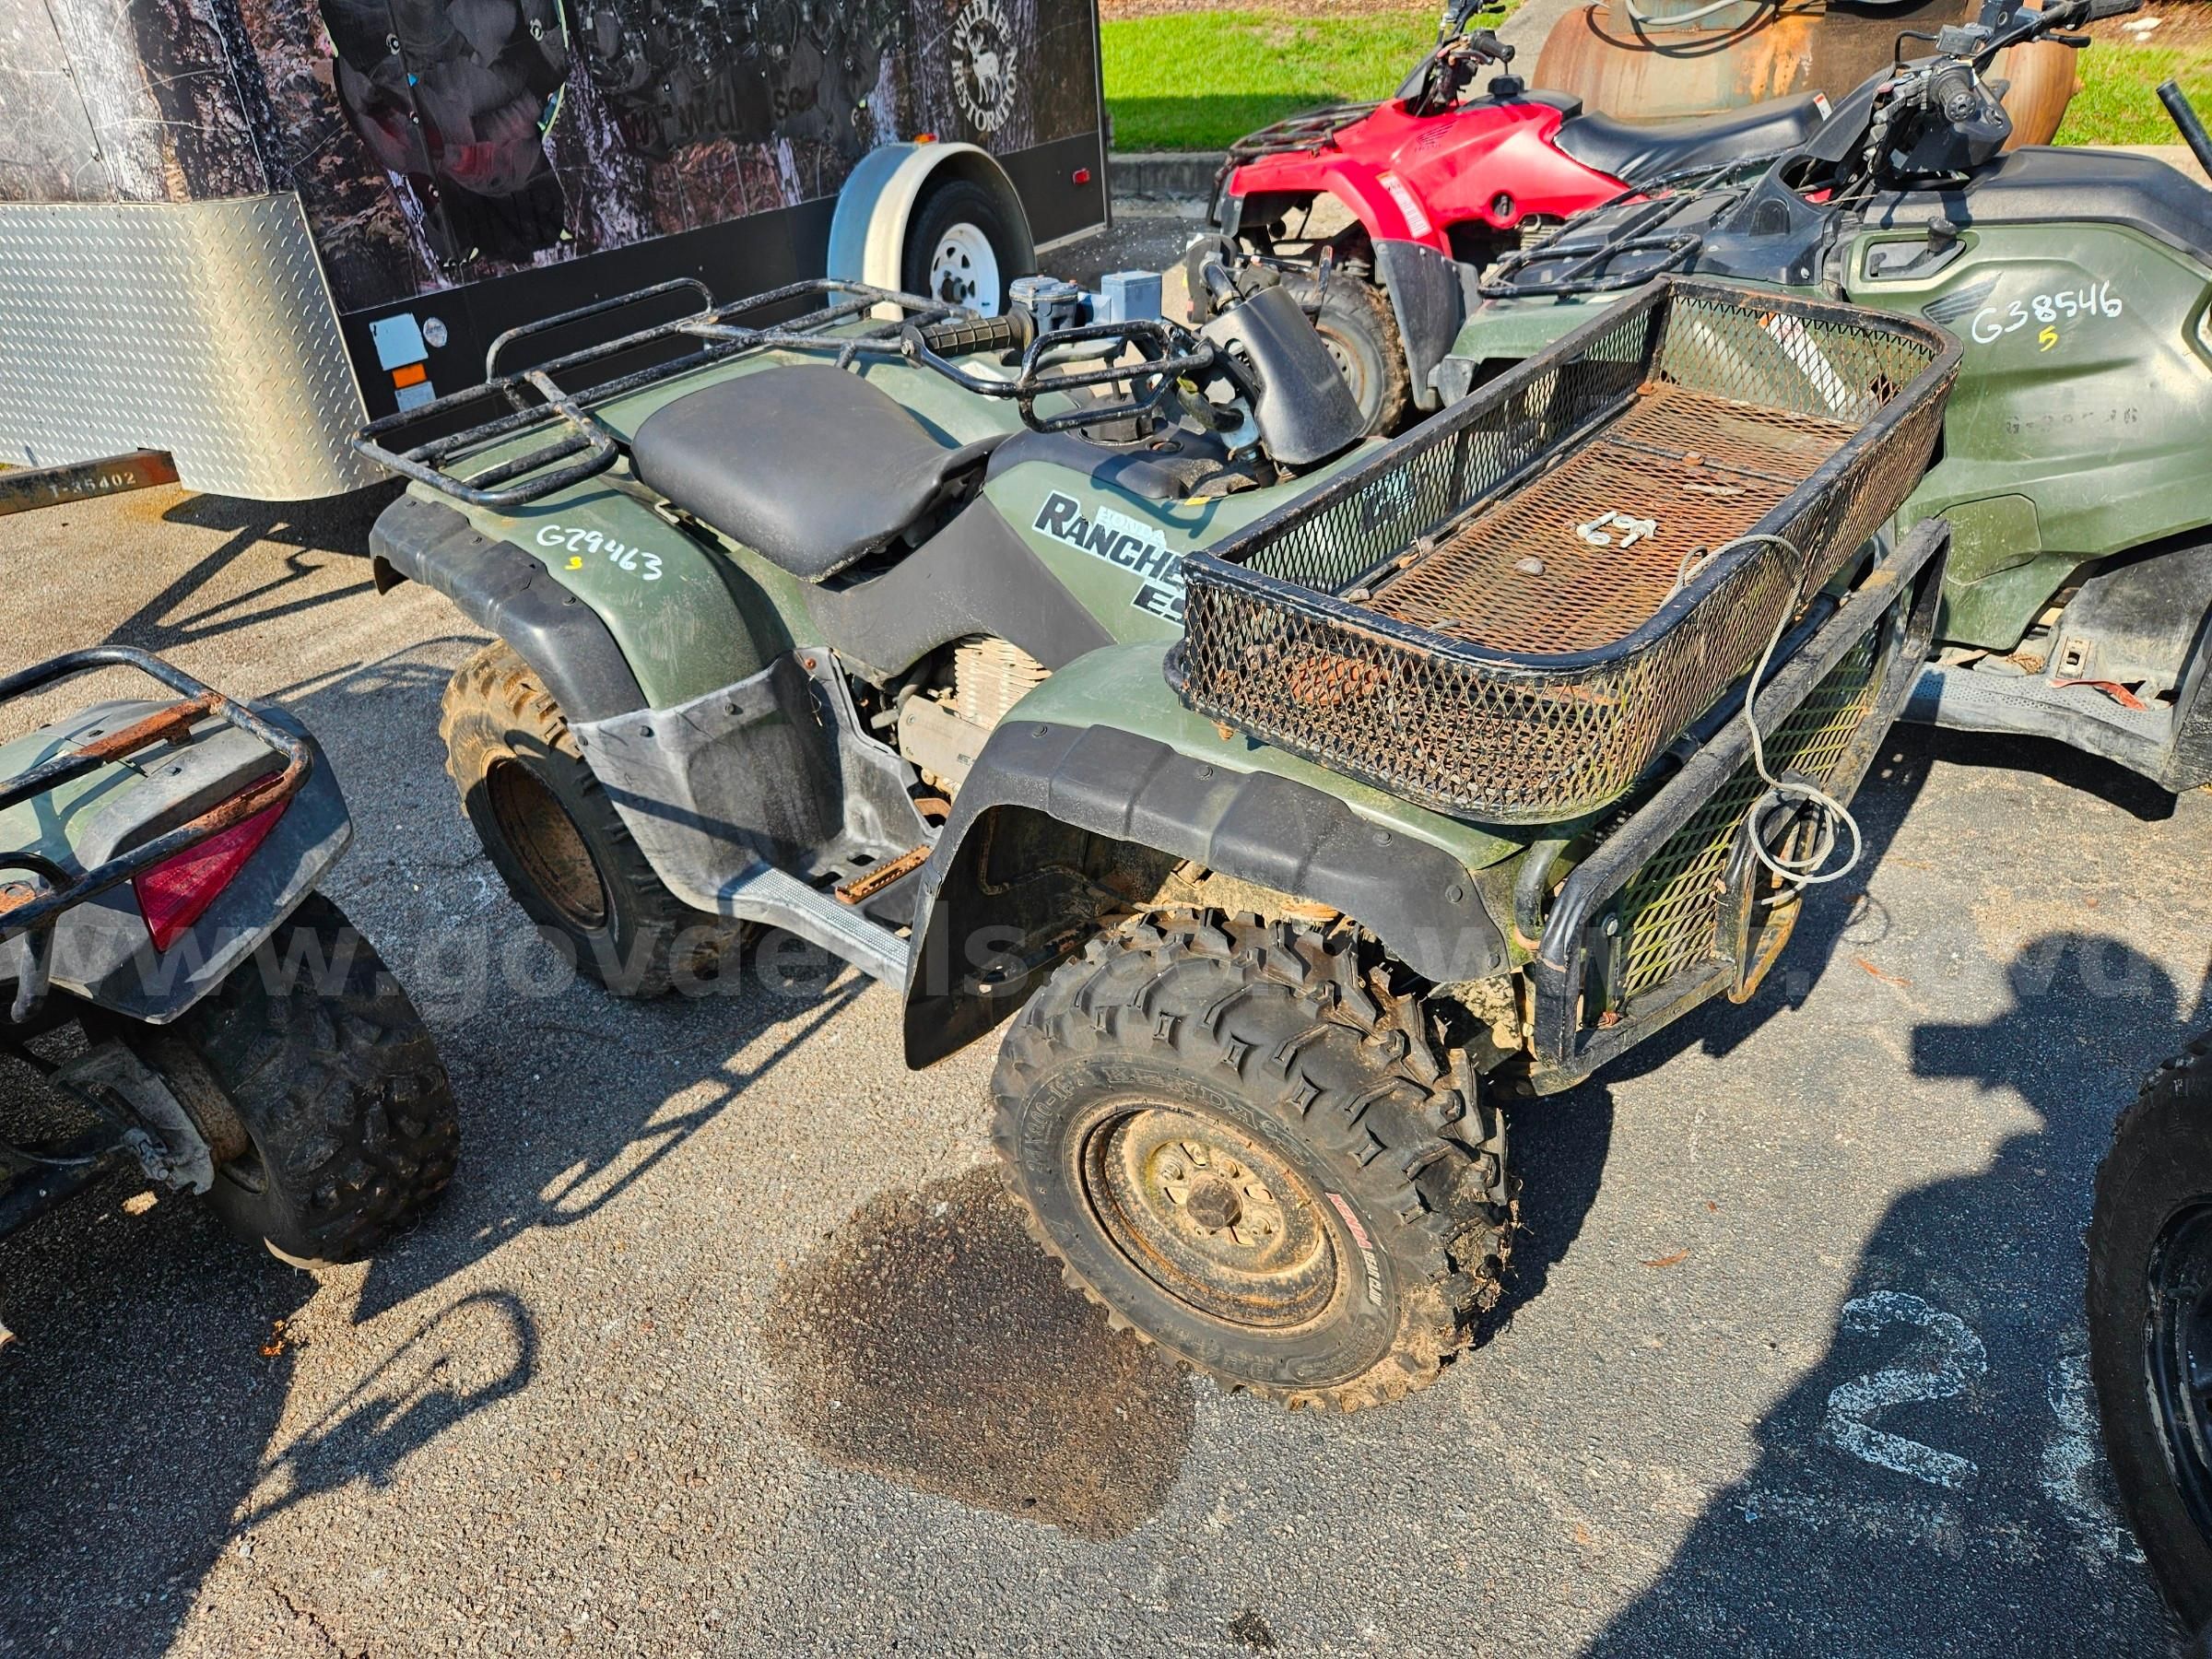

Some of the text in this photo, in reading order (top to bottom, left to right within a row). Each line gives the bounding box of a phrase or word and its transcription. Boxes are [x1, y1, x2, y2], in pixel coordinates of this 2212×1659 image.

[951, 46, 1018, 132] RESTORATION
[1971, 279, 2123, 344] G38546
[2038, 324, 2059, 352] 5
[1325, 1193, 1382, 1306] KENDA BEAR CLAW
